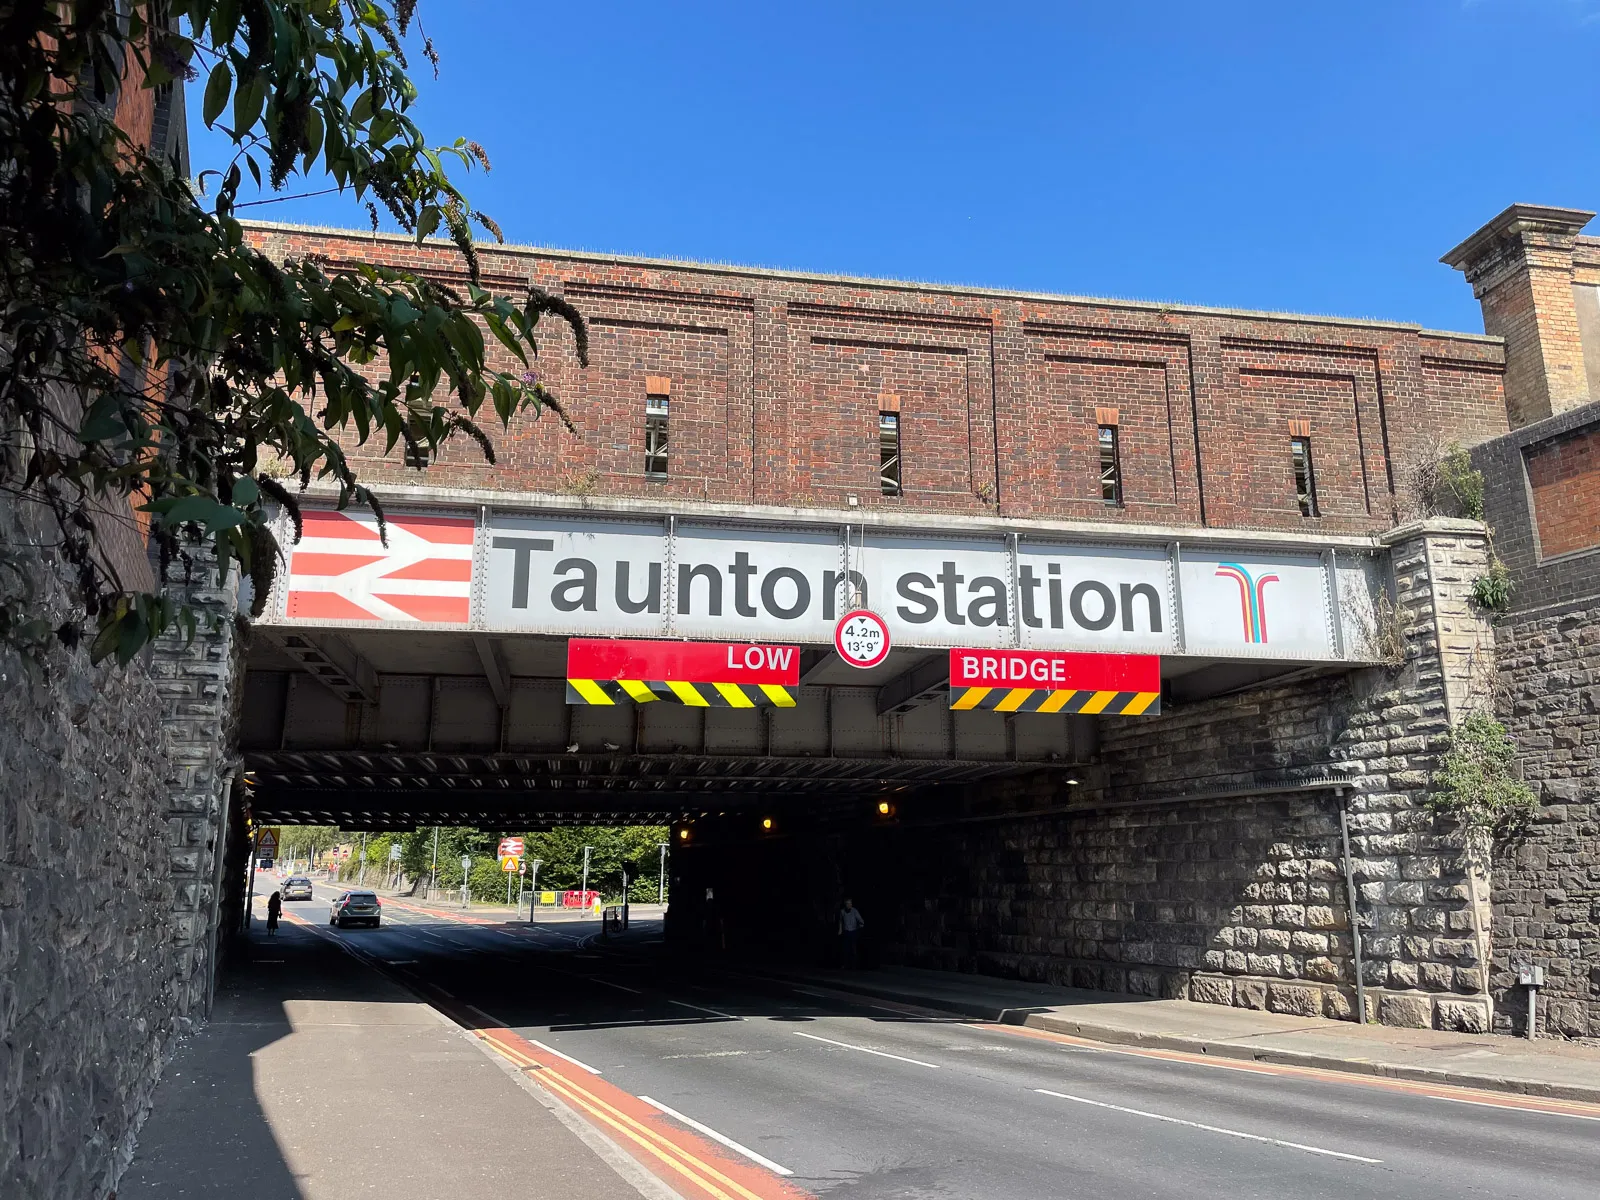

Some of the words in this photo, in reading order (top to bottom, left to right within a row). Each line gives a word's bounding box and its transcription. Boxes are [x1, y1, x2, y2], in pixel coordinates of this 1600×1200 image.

[492, 536, 868, 621] Taunton
[895, 560, 1163, 633] station
[845, 625, 880, 638] 4.2m
[727, 645, 793, 671] LOW
[962, 655, 1066, 682] BRIDGE
